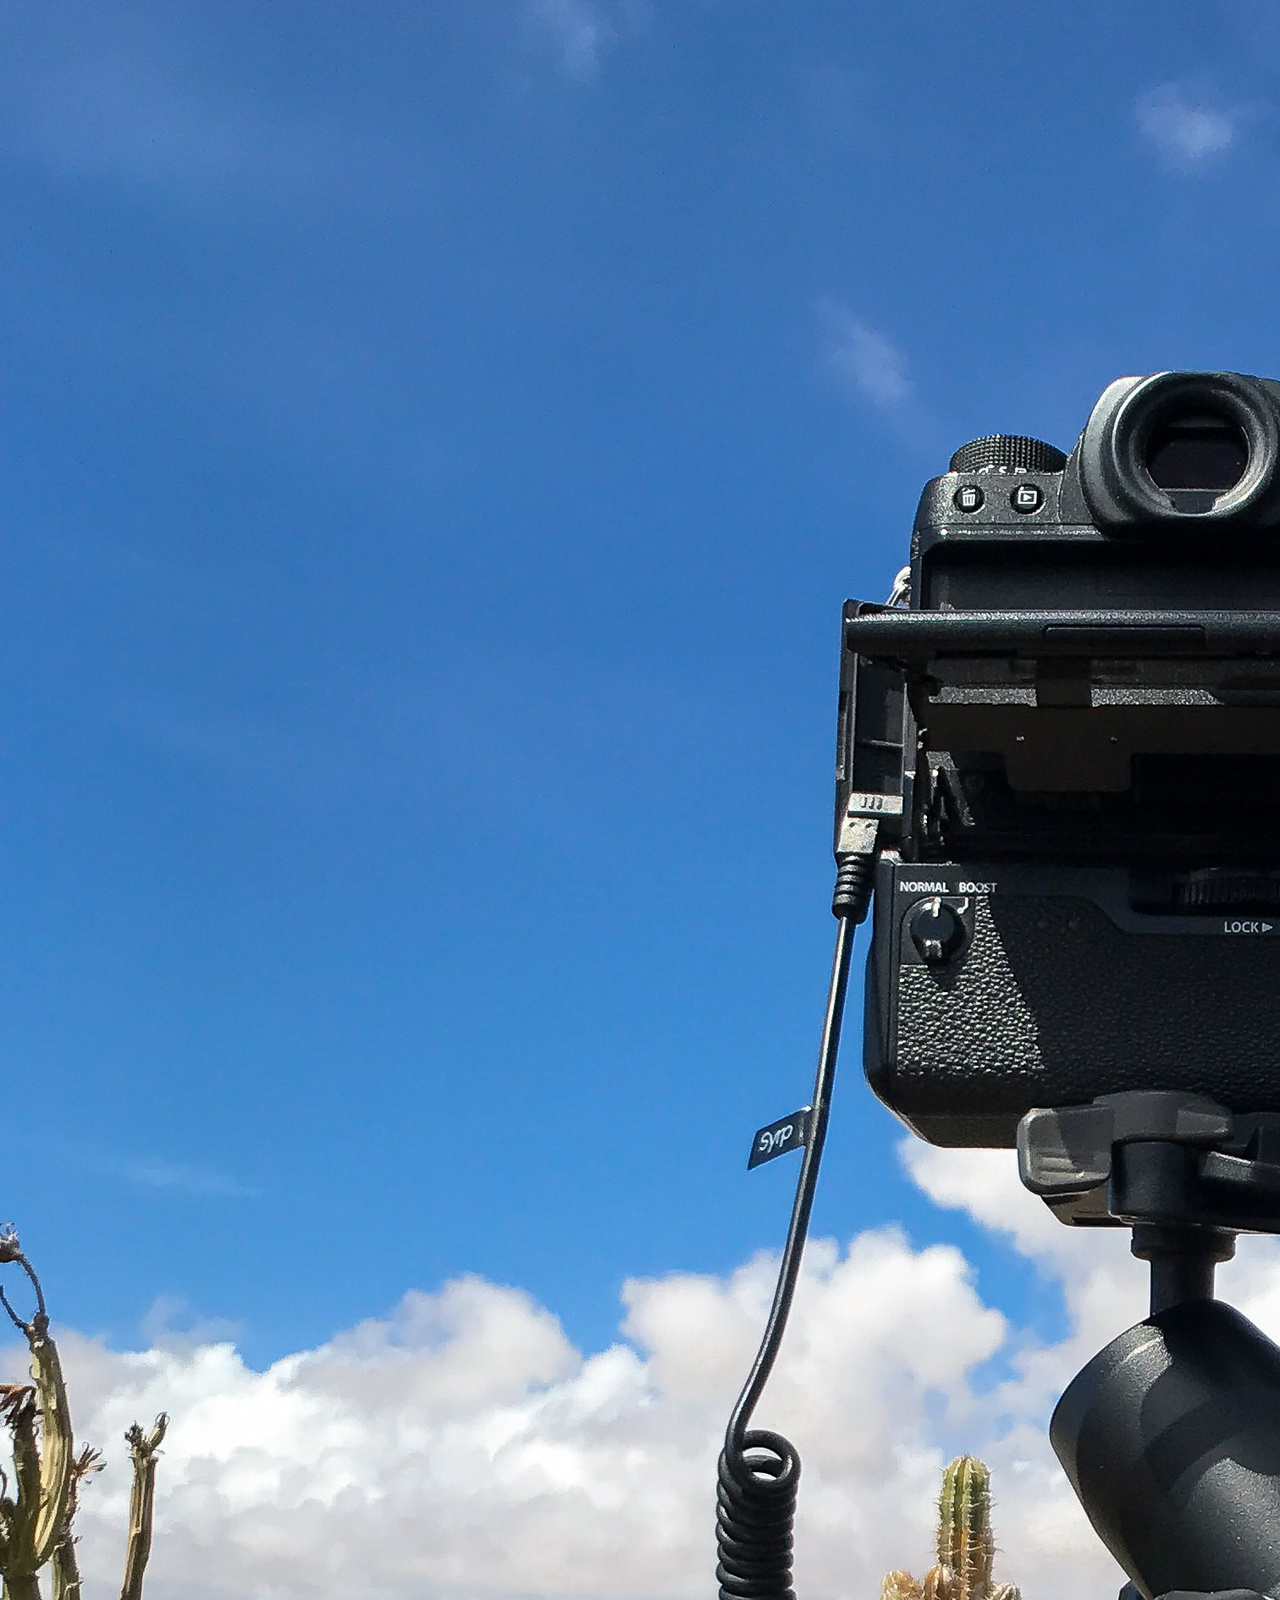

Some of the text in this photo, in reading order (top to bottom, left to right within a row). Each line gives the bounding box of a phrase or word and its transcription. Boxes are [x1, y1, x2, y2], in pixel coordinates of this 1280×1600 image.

[900, 881, 998, 894] NORMAL BOOST
[1224, 921, 1259, 934] LOCK
[758, 1124, 794, 1154] syrp
